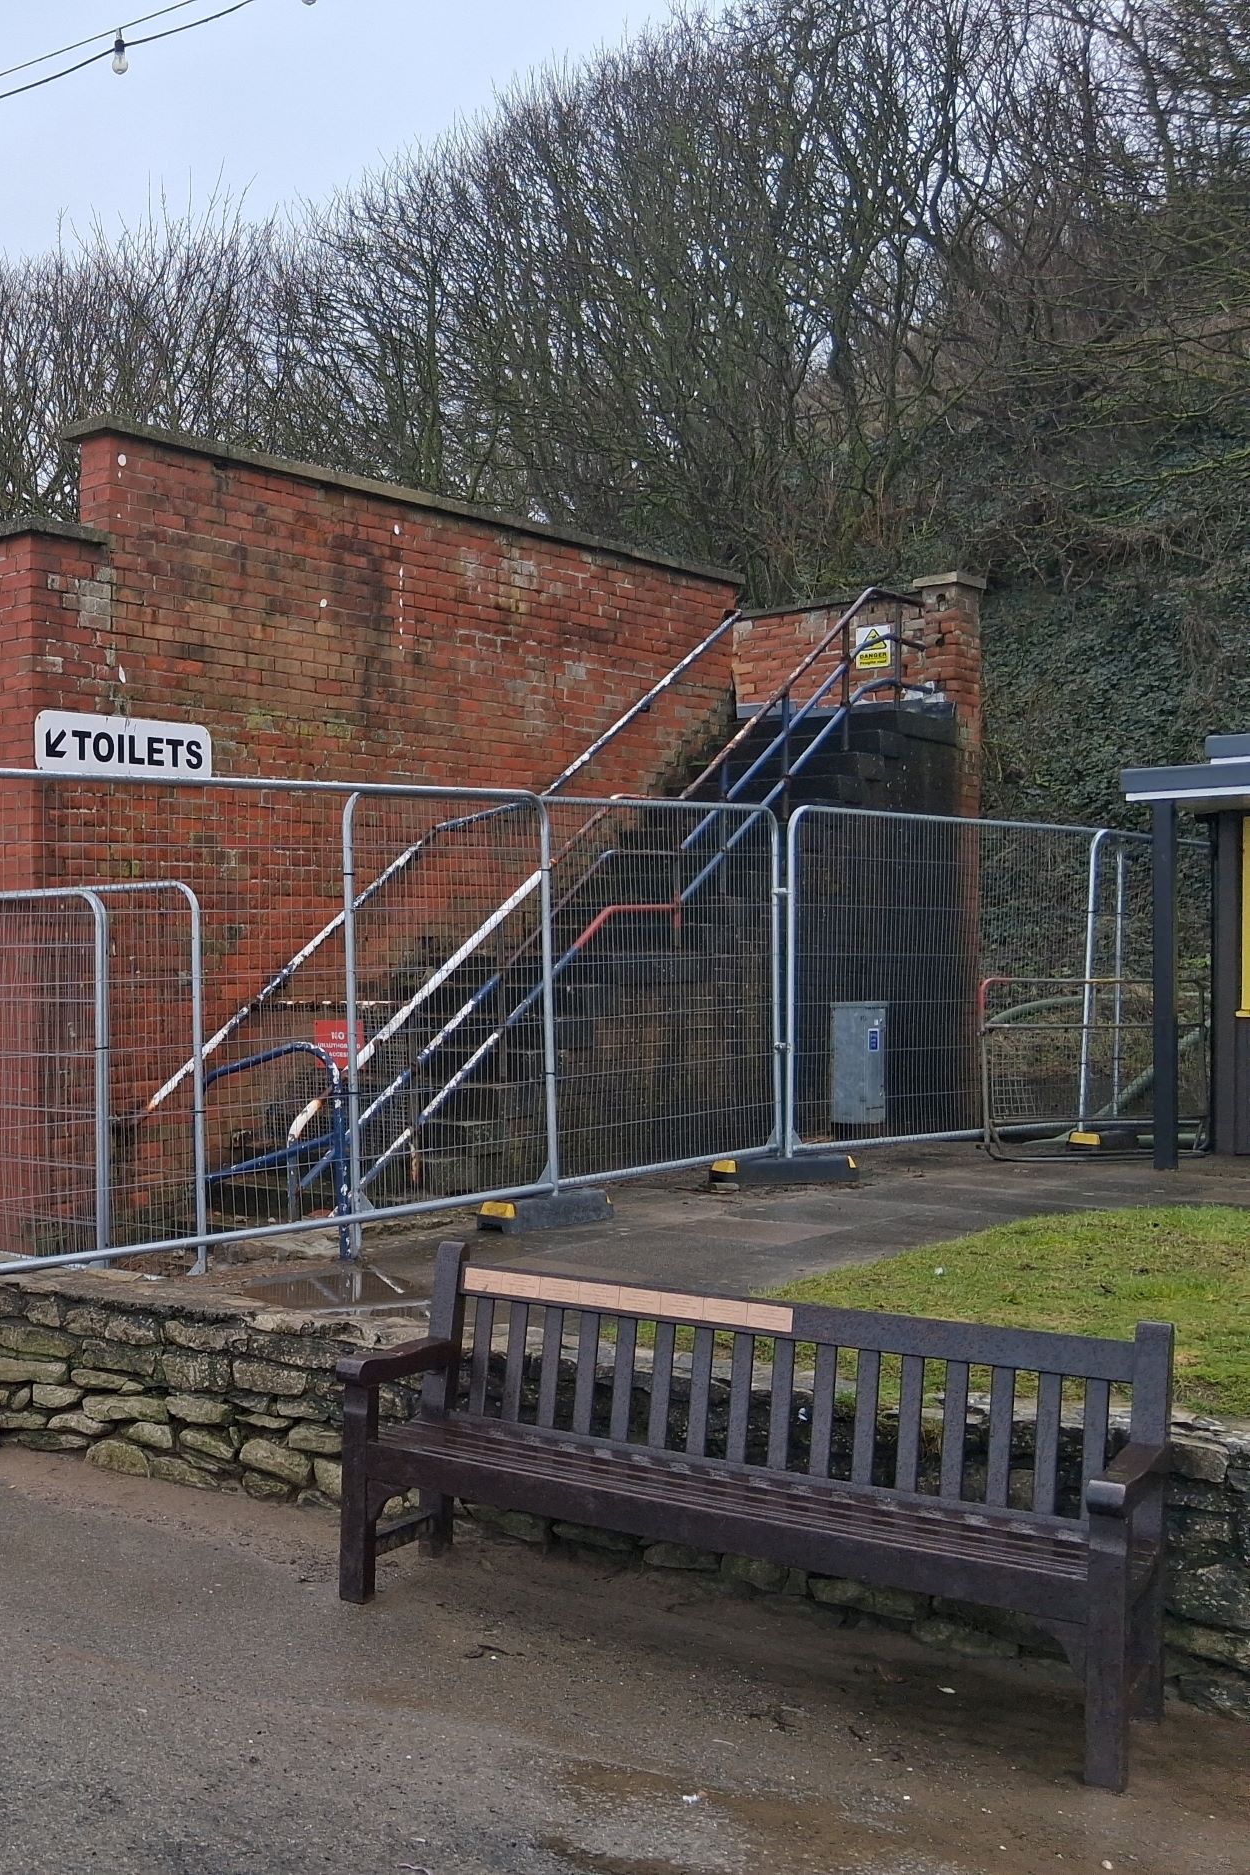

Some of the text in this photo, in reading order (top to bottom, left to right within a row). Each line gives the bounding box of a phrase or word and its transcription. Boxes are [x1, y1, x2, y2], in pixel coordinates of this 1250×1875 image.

[859, 652, 887, 660] DANGER
[71, 729, 203, 770] TOILETS
[331, 1031, 345, 1040] NO
